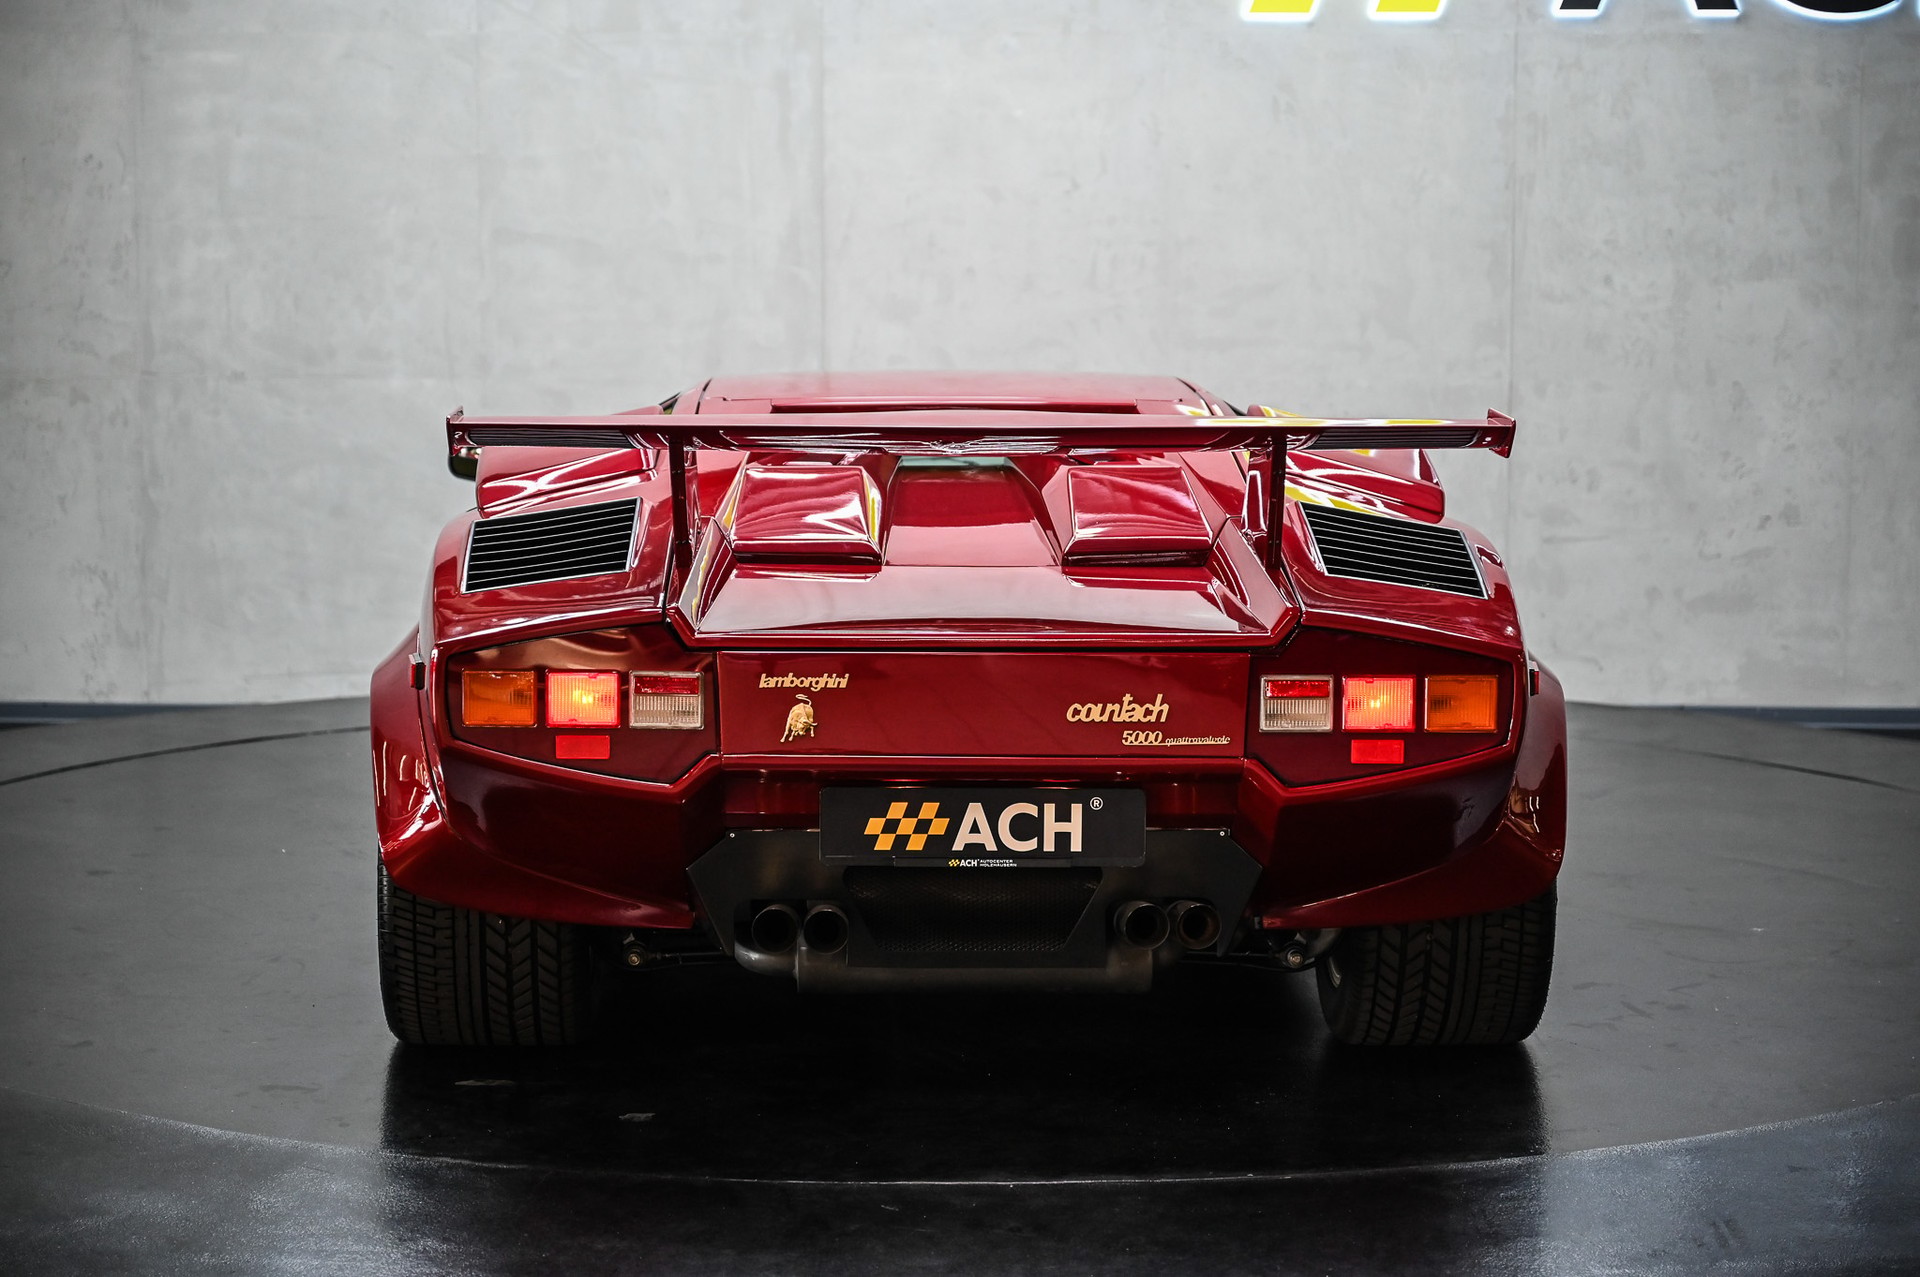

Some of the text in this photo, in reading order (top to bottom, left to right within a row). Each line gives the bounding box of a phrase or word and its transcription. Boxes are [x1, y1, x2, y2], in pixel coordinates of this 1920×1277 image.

[759, 673, 849, 692] lamborghini
[1066, 693, 1169, 722] countach
[1122, 730, 1162, 745] 5000
